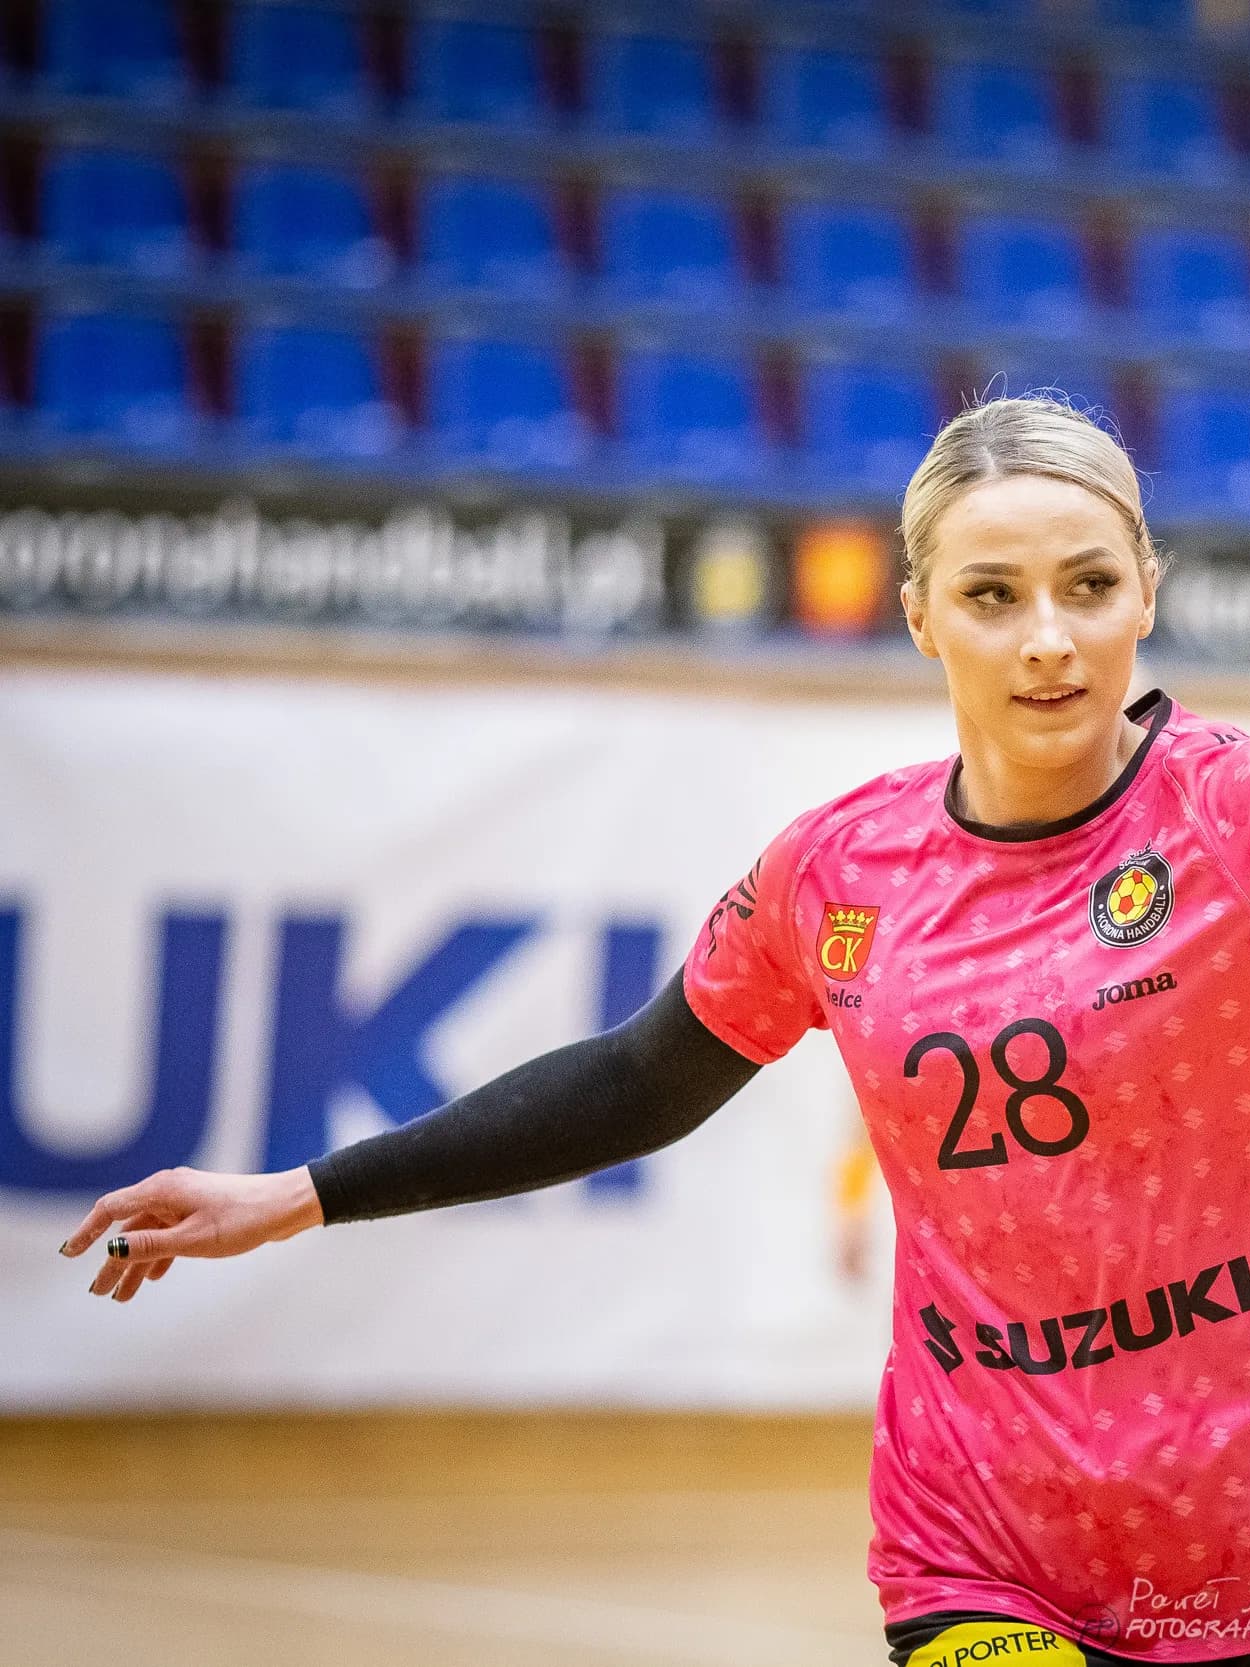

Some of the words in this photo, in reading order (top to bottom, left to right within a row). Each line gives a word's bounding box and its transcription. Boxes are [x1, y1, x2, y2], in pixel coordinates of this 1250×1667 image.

[1126, 893, 1167, 940] HANDBALL
[821, 935, 864, 972] CK
[903, 1017, 1090, 1171] 28
